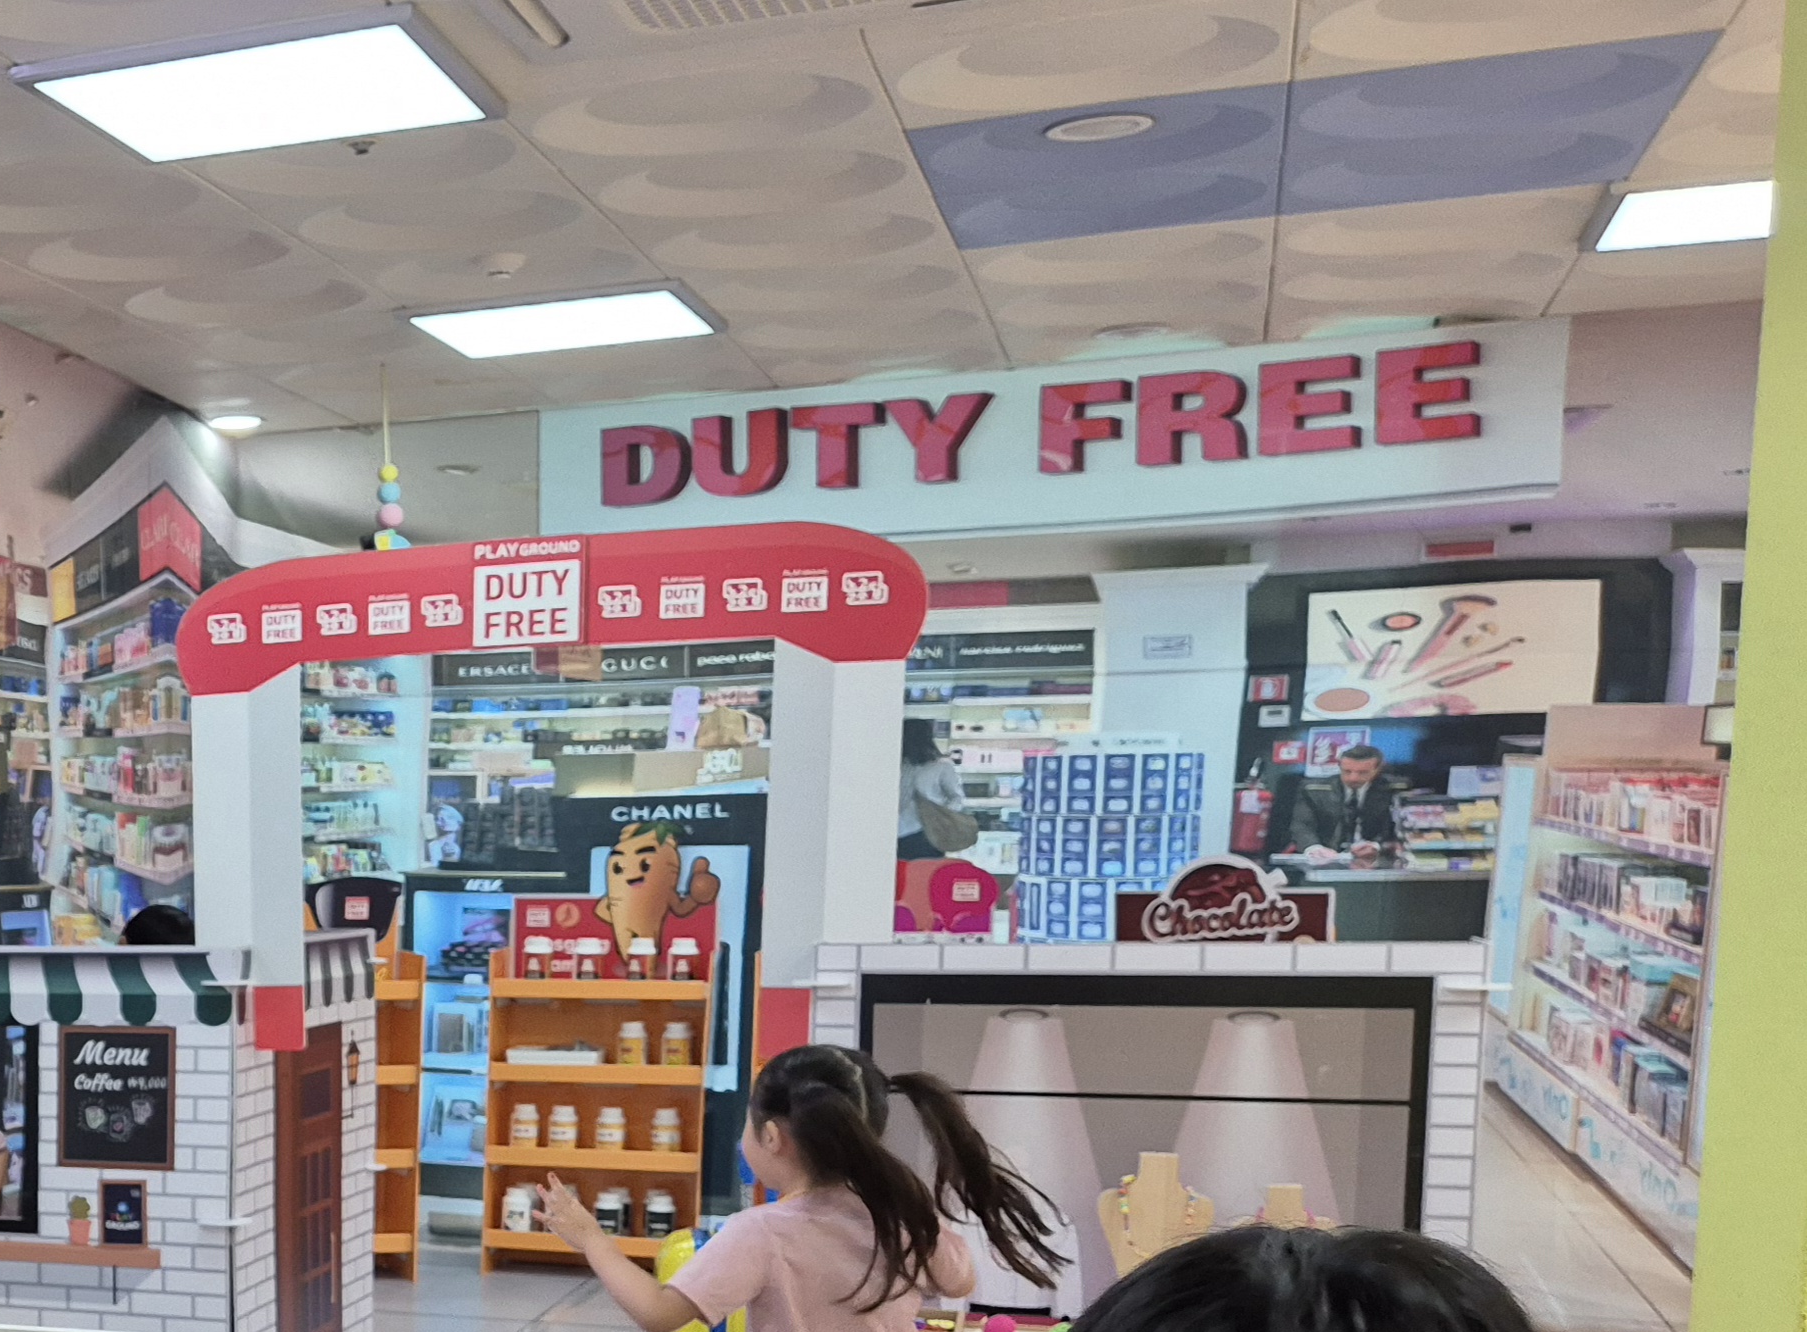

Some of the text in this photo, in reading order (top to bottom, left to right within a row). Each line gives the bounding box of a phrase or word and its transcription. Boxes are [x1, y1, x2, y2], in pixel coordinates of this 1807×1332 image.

[600, 340, 1481, 508] DUTY FREE
[474, 540, 581, 560] PLAYGROUND
[485, 569, 570, 601] DUTY
[787, 581, 823, 594] DUTY
[665, 588, 699, 600] DUTY
[373, 605, 405, 617] DUTY
[664, 604, 698, 614] FREE
[786, 597, 821, 609] FREE
[266, 615, 296, 626] DUTY
[373, 619, 405, 631] FREE
[484, 608, 568, 639] FREE
[266, 629, 296, 639] FREE
[610, 802, 730, 822] CHANEL
[1146, 893, 1297, 939] Chocolate
[73, 1039, 150, 1066] Menu
[74, 1072, 124, 1093] Coffee
